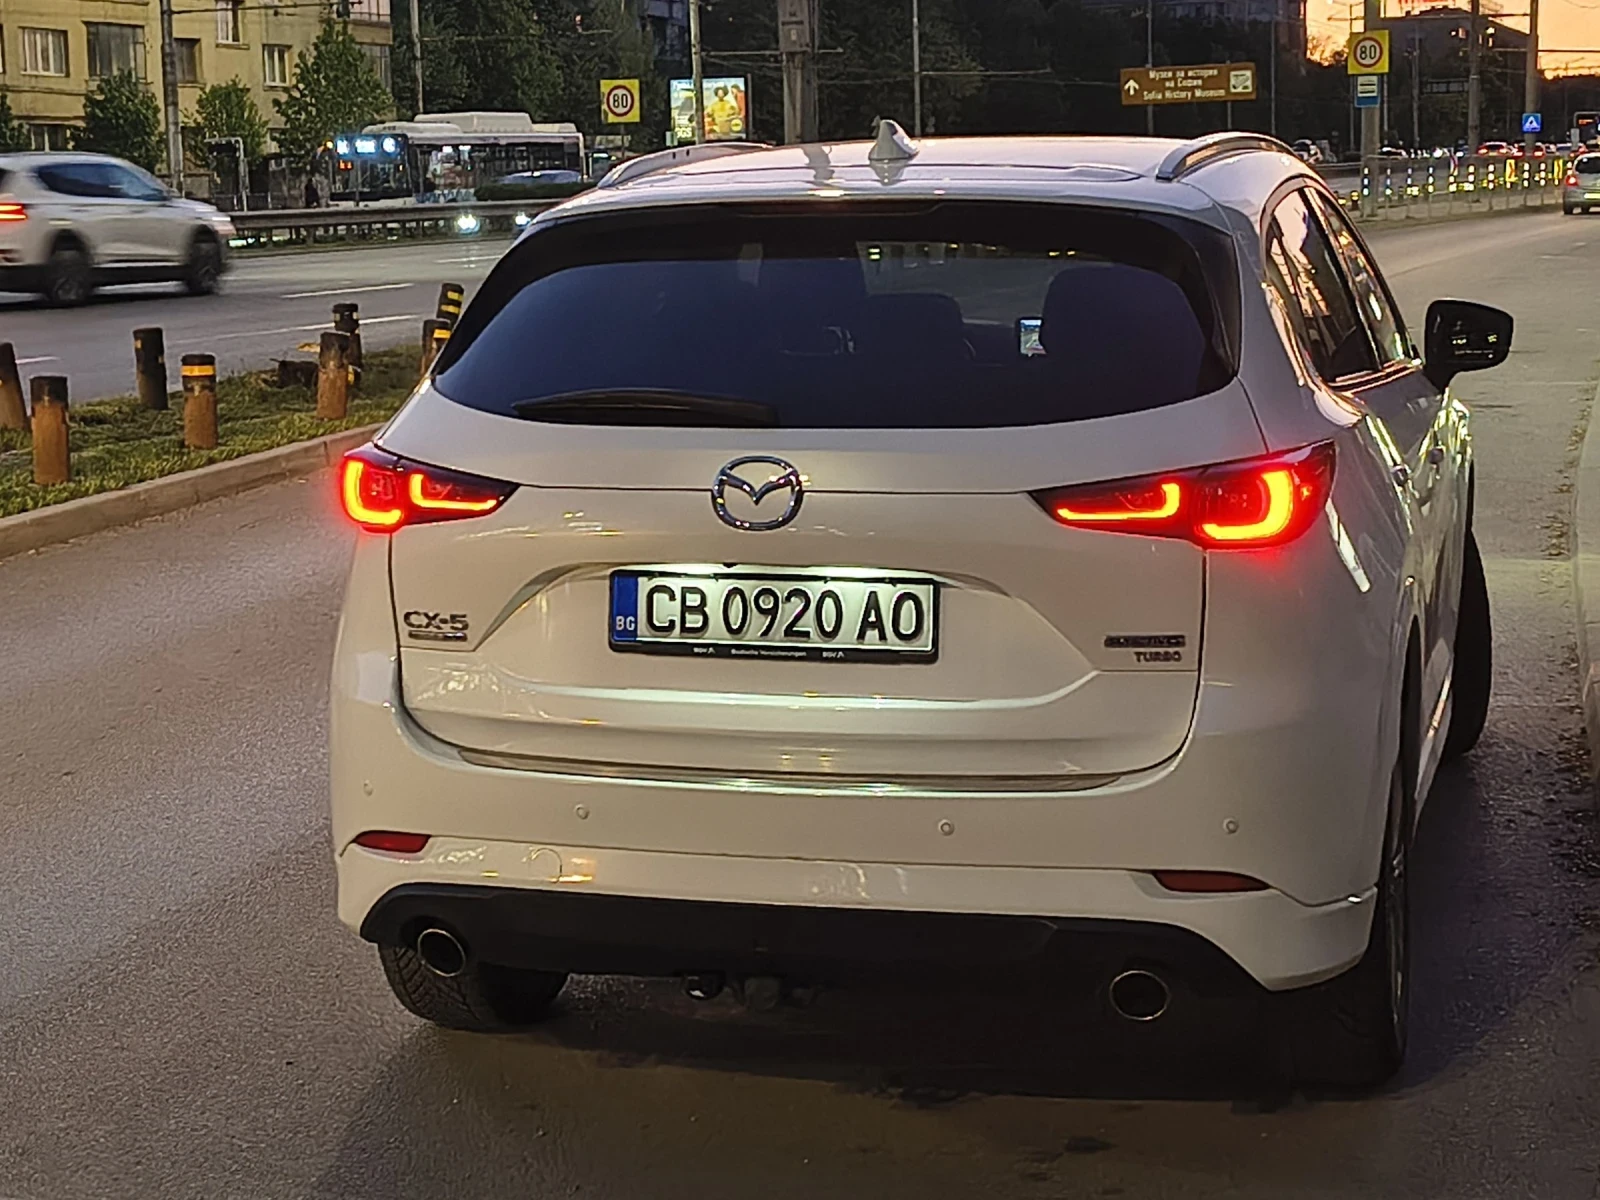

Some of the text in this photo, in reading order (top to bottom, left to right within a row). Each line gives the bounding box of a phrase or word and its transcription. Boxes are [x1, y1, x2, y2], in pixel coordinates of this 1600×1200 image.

[1360, 45, 1377, 60] 80
[612, 93, 628, 109] 80
[1143, 88, 1226, 100] Sofia History Museum
[403, 610, 469, 630] CX-5
[646, 585, 926, 642] CB 0920 AO
[615, 615, 636, 631] BG
[1133, 650, 1182, 663] TURBO
